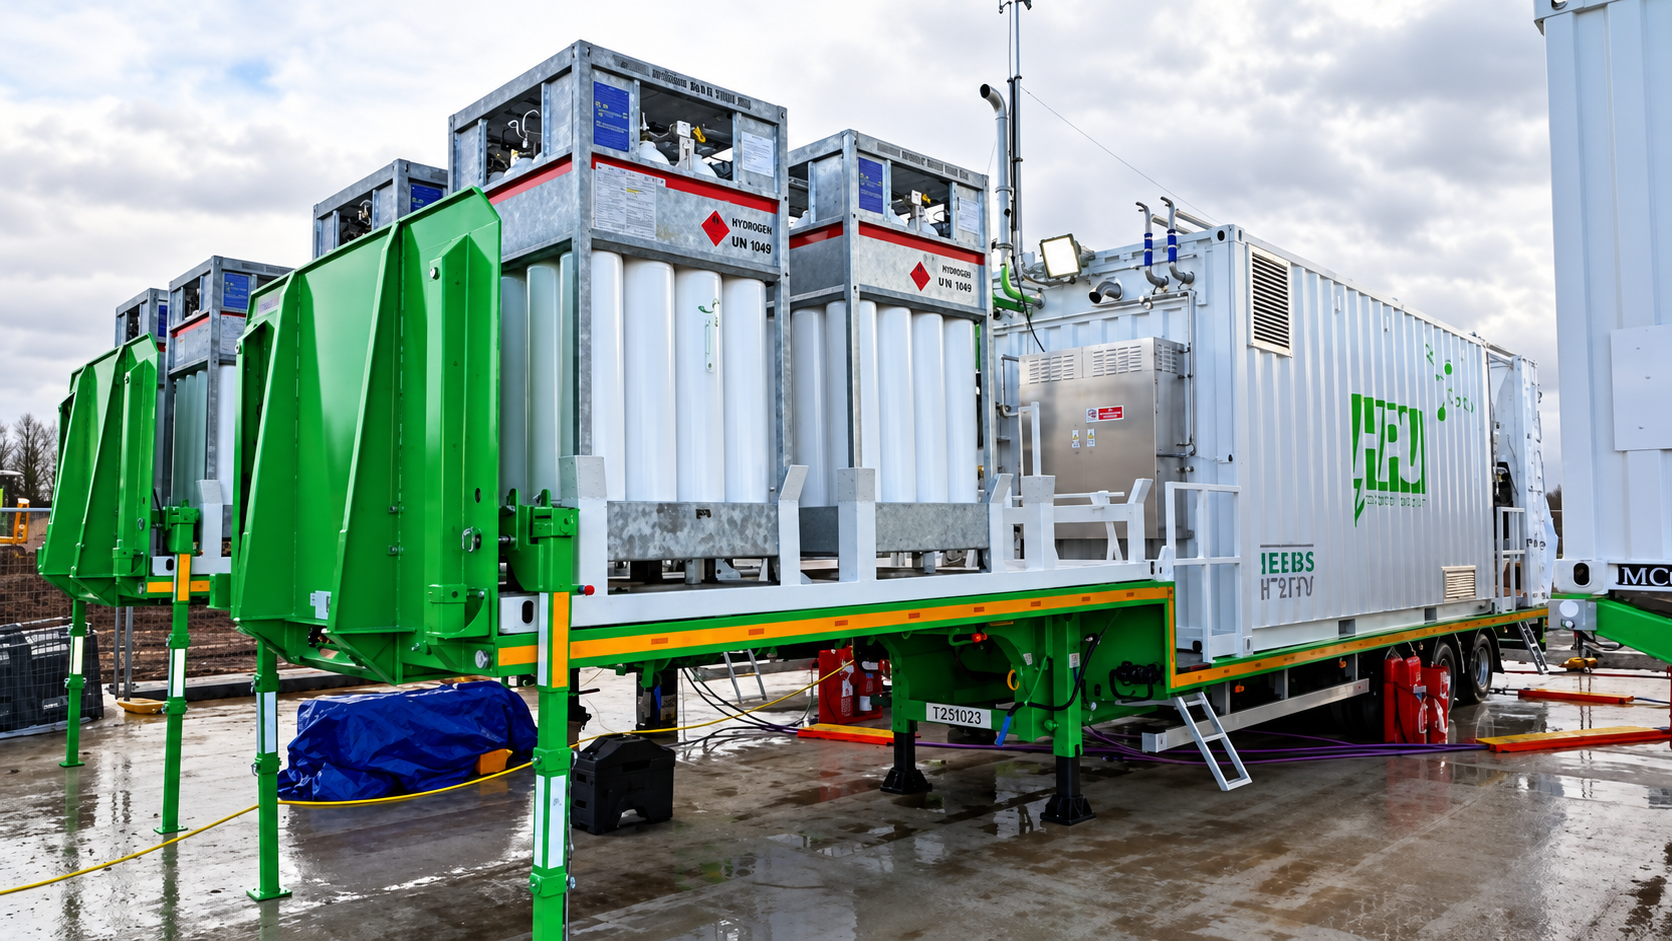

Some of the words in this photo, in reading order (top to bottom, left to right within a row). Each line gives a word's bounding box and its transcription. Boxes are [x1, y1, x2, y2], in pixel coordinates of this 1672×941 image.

[731, 217, 773, 236] HYDROGEN
[731, 235, 748, 250] UN
[750, 239, 772, 255] 1049
[938, 277, 953, 289] UN
[955, 281, 972, 293] 1049
